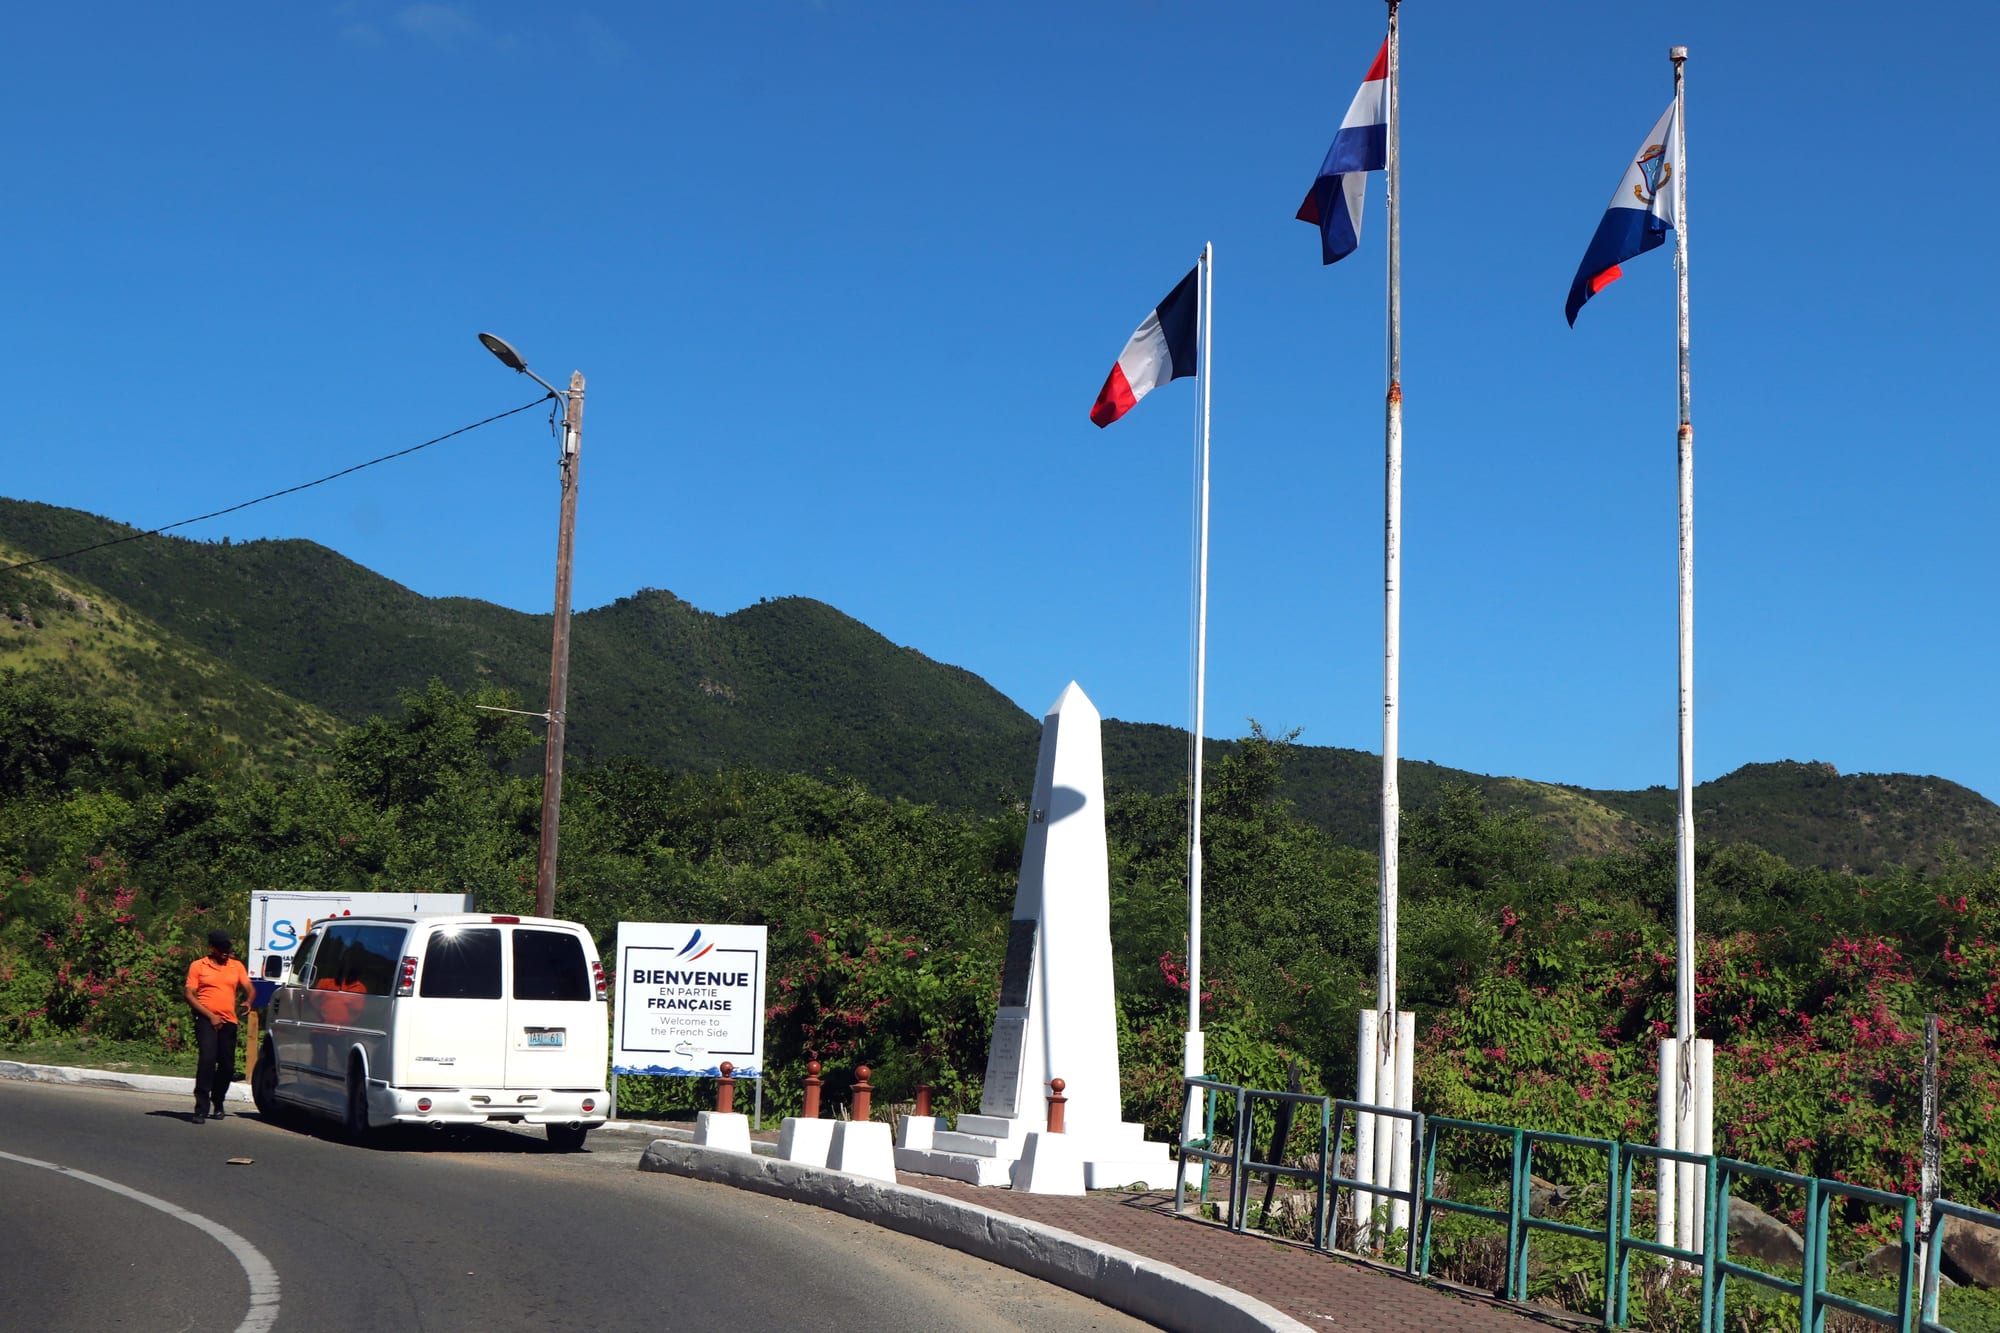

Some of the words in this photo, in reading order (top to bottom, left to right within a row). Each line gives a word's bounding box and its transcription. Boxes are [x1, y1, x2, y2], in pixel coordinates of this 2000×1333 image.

[633, 969, 749, 987] BIENVENUE
[659, 987, 675, 996] EN
[678, 988, 718, 998] PARTIE
[647, 998, 732, 1012] FRANÇAISE
[660, 1016, 707, 1026] Welcome
[709, 1018, 720, 1026] to
[651, 1027, 667, 1036] the
[670, 1027, 704, 1037] French
[706, 1028, 728, 1037] Side
